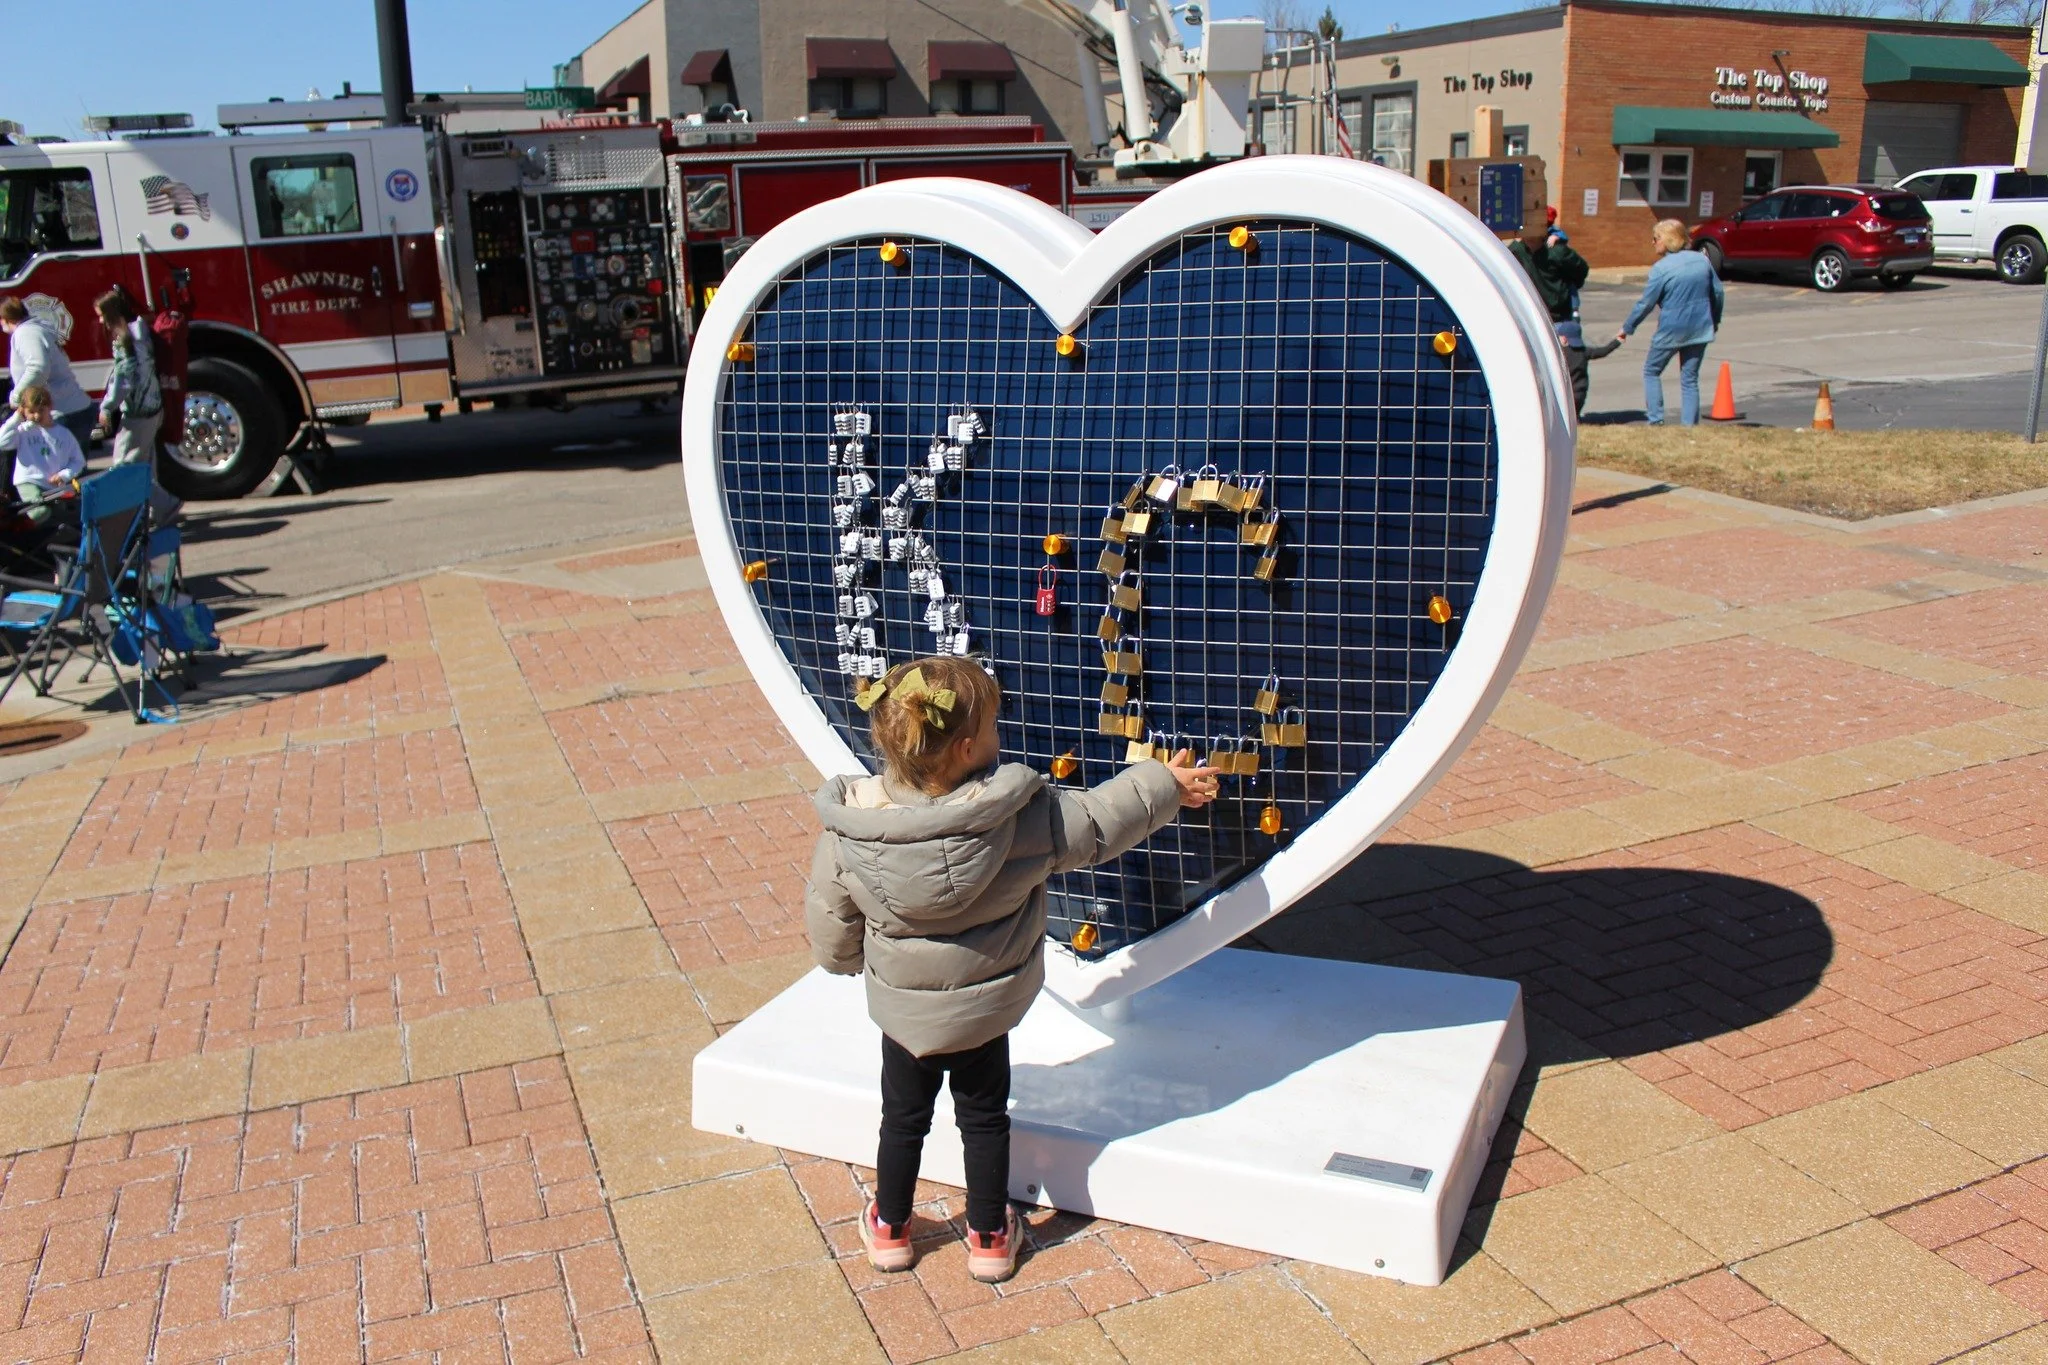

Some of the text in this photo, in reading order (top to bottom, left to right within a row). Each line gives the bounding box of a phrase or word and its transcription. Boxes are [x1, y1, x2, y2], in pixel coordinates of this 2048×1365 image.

[1443, 69, 1533, 94] The Top Shop
[1714, 66, 1828, 95] The Top Shop
[525, 90, 580, 107] BARTO
[1710, 91, 1828, 111] Custom Counter Tops
[260, 271, 365, 300] SHAWNEE
[270, 300, 310, 316] FIRE
